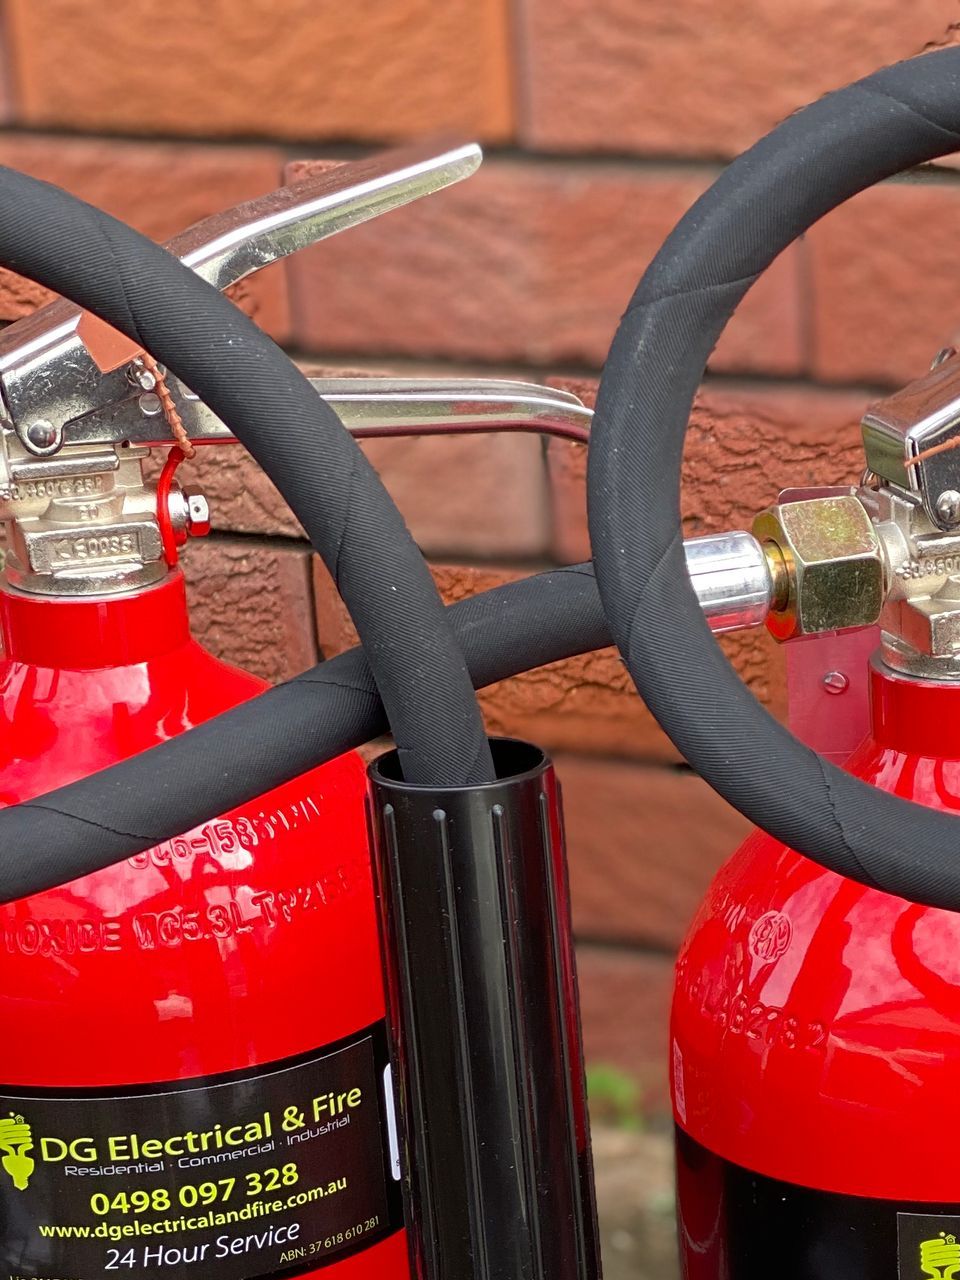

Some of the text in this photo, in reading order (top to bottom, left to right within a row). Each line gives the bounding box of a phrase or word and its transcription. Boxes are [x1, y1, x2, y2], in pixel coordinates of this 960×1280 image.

[41, 1087, 362, 1162] DG Electrical & Fire
[64, 1115, 350, 1176] Residential Commercial Industrial
[38, 1177, 347, 1241] www.dgelectricalandfire.com.au
[90, 1163, 299, 1215] 0498 097 328
[105, 1223, 300, 1269] 24 Hour Service
[280, 1216, 379, 1263] ABN: 37 618 610 281
